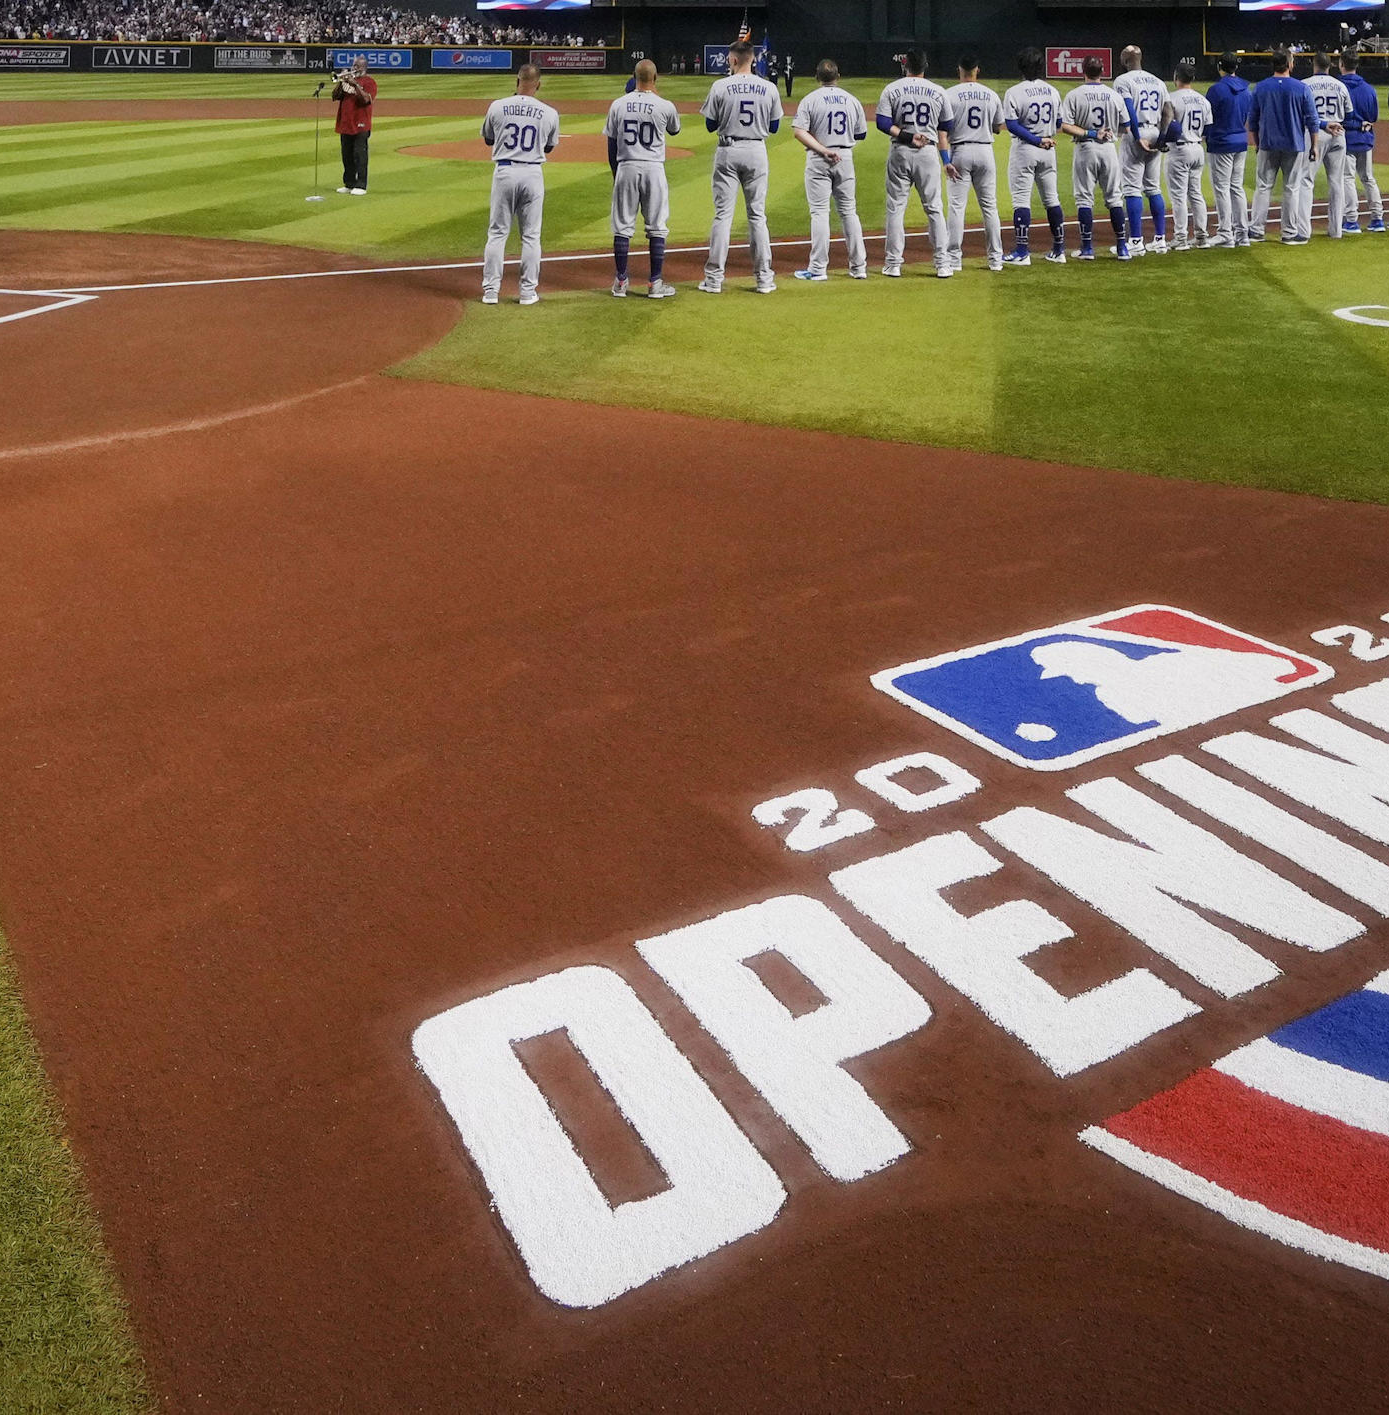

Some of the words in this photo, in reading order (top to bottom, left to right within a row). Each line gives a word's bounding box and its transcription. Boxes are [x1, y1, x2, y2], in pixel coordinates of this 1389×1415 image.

[104, 49, 181, 65] AVNET
[217, 50, 231, 59] HIT
[233, 50, 248, 59] THE
[466, 54, 492, 64] pepsi
[631, 51, 645, 59] 413
[308, 60, 324, 69] 374
[727, 84, 767, 96] FREEMAN
[958, 92, 991, 102] PERALTA
[1025, 87, 1052, 97] OUTMAN
[1084, 93, 1111, 102] TAYLOR
[626, 102, 654, 115] BETTS
[823, 96, 848, 105] MUNCY
[1139, 90, 1160, 111] 23
[1314, 96, 1338, 118] 25
[503, 105, 545, 120] ROBERTS
[740, 101, 754, 127] 5
[901, 101, 931, 127] 28
[967, 106, 981, 129] 6
[1029, 102, 1052, 124] 33
[1092, 107, 1105, 128] 3
[1187, 110, 1202, 131] 15
[827, 111, 847, 135] 13
[503, 123, 537, 152] 30
[623, 120, 655, 147] 50
[752, 751, 982, 854] 20
